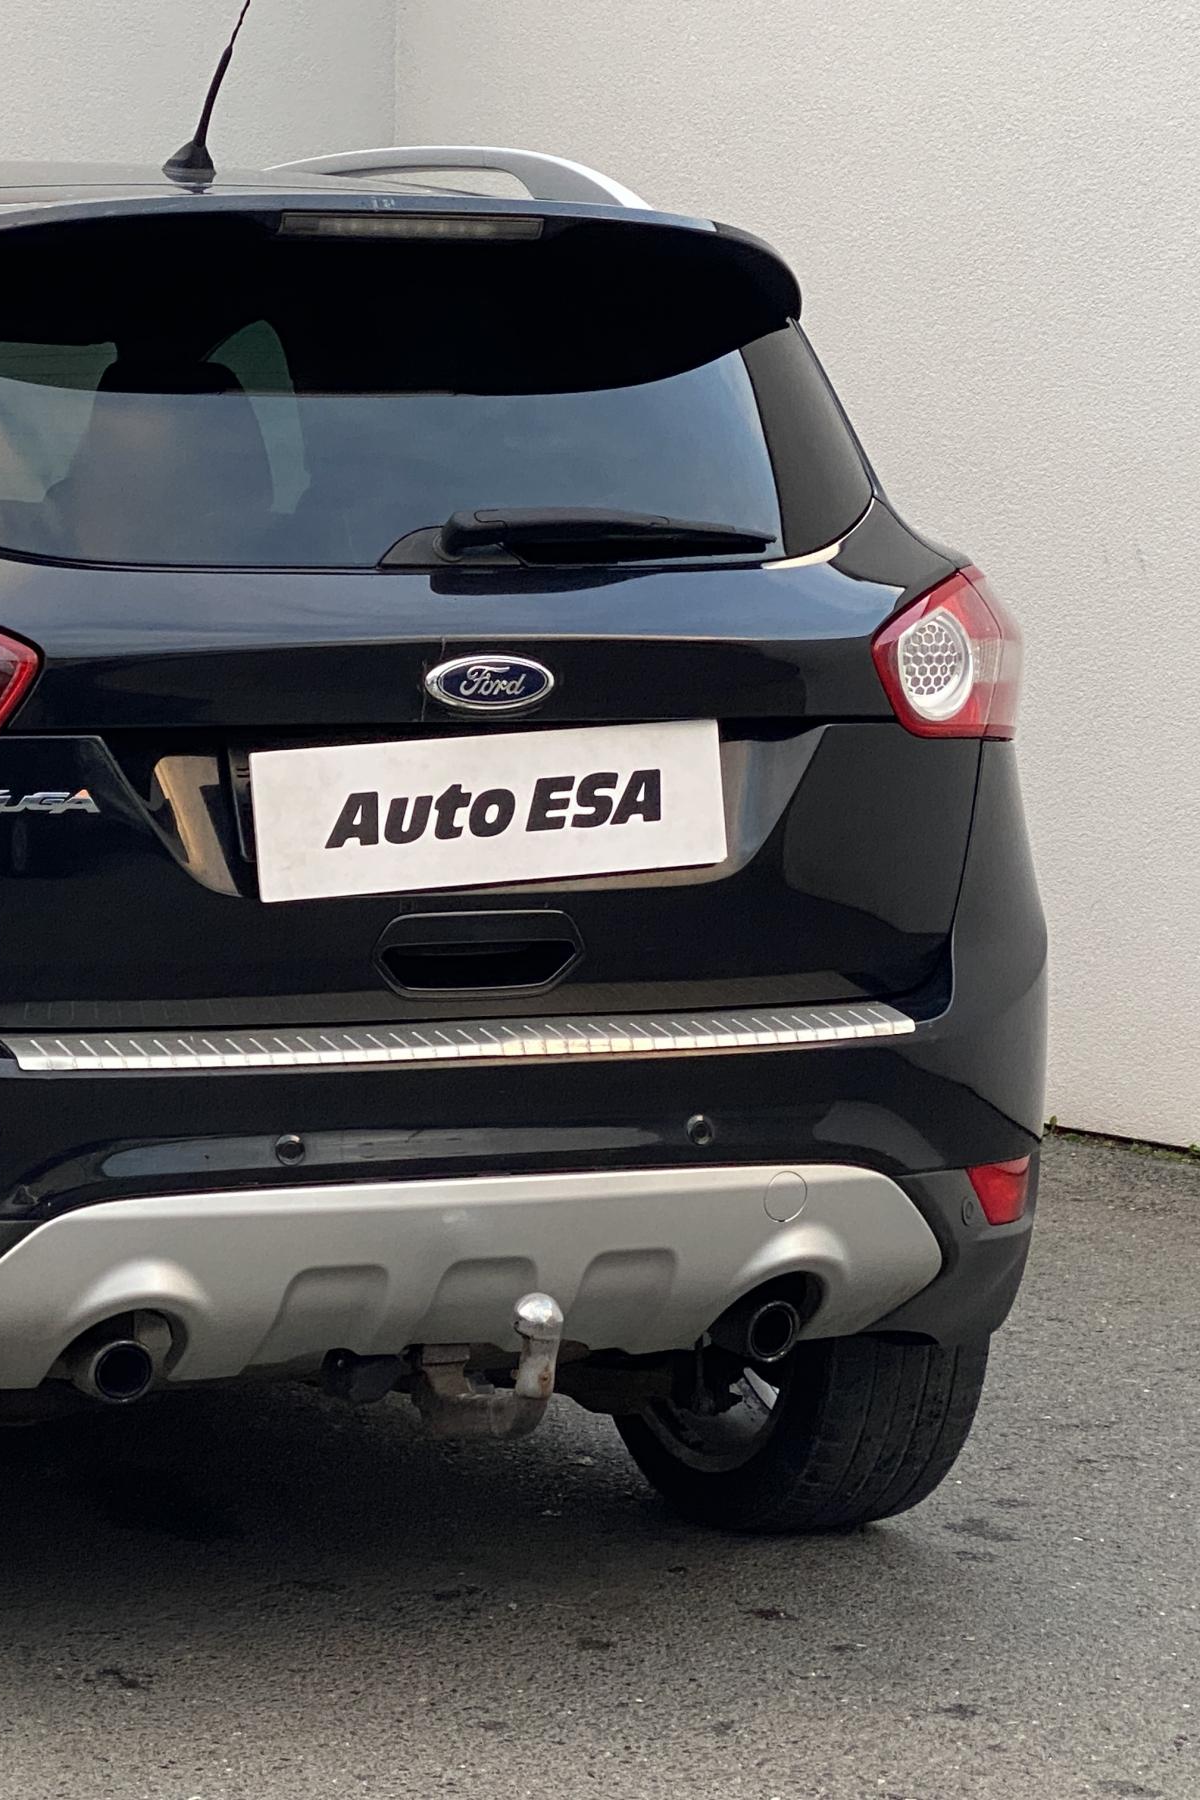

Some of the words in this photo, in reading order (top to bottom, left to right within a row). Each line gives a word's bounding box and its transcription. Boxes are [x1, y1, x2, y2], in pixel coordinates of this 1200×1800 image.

[459, 665, 526, 696] Ford
[324, 783, 516, 849] Auto
[525, 768, 662, 832] ESA
